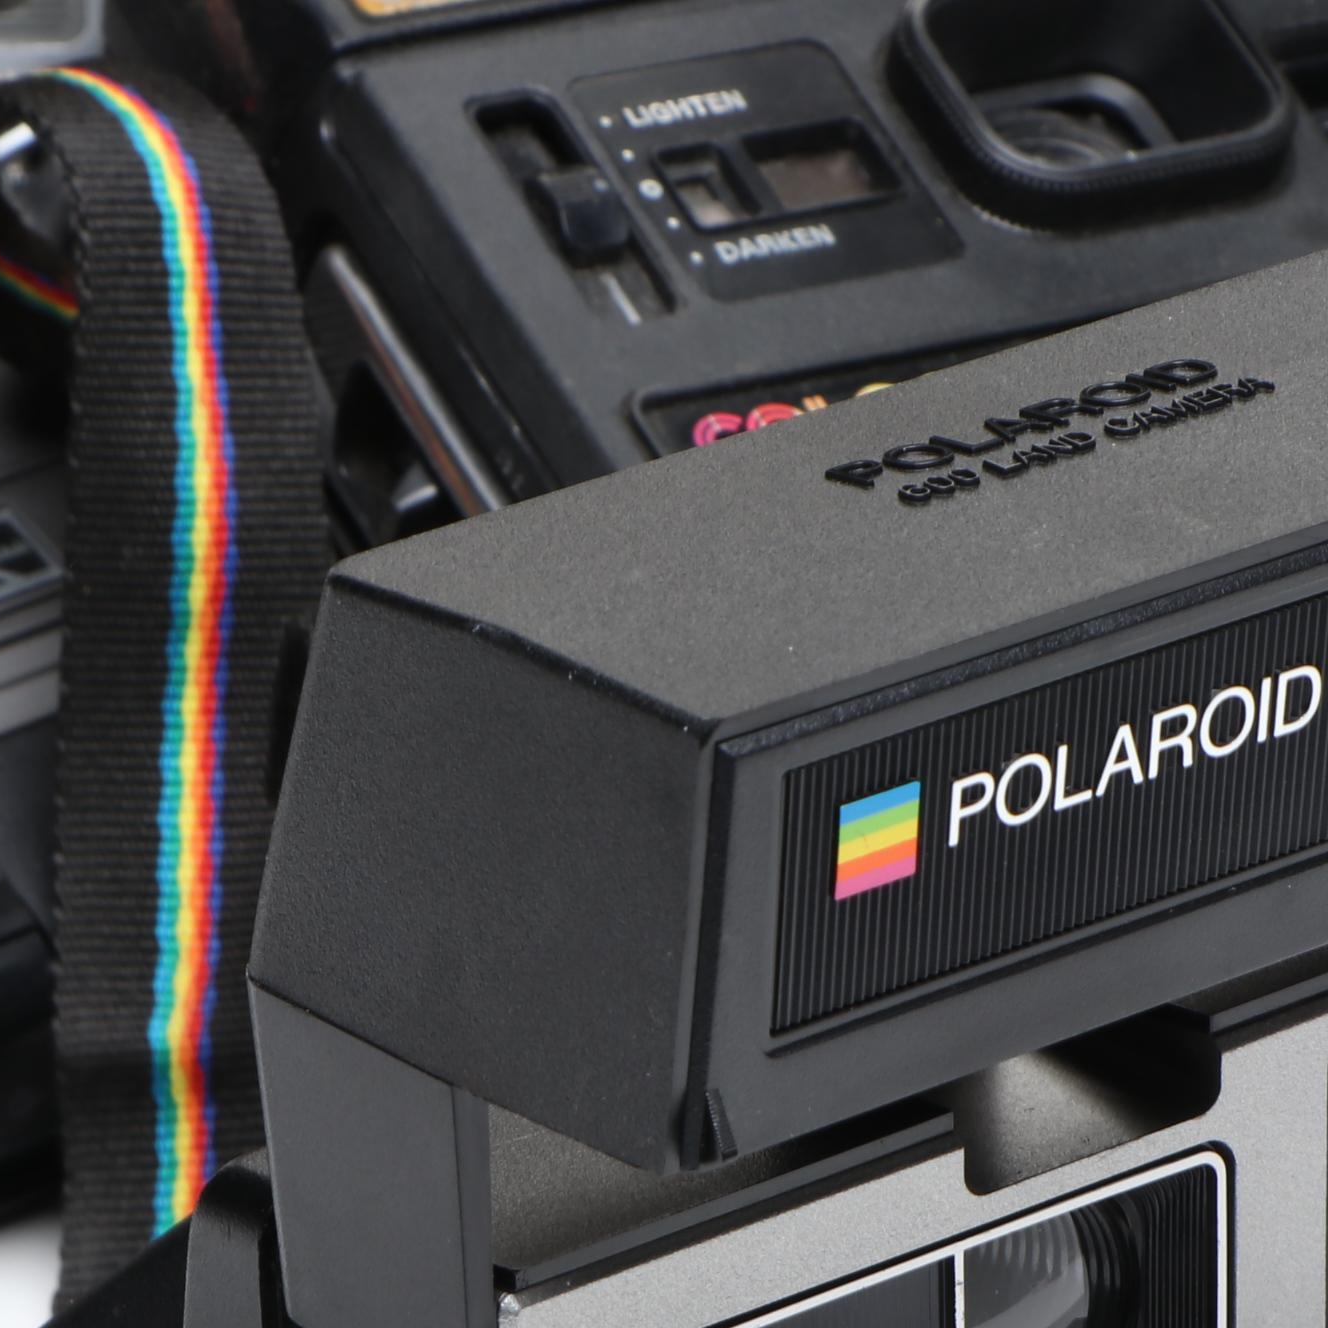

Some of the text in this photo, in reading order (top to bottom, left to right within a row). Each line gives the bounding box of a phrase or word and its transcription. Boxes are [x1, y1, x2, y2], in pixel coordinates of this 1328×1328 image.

[622, 88, 748, 129] LIGHTEN
[712, 223, 837, 264] DARKEN
[824, 358, 1218, 488] POLAROID
[897, 376, 1276, 504] 600 LAND CAMERA
[947, 664, 1323, 848] POLAROID
